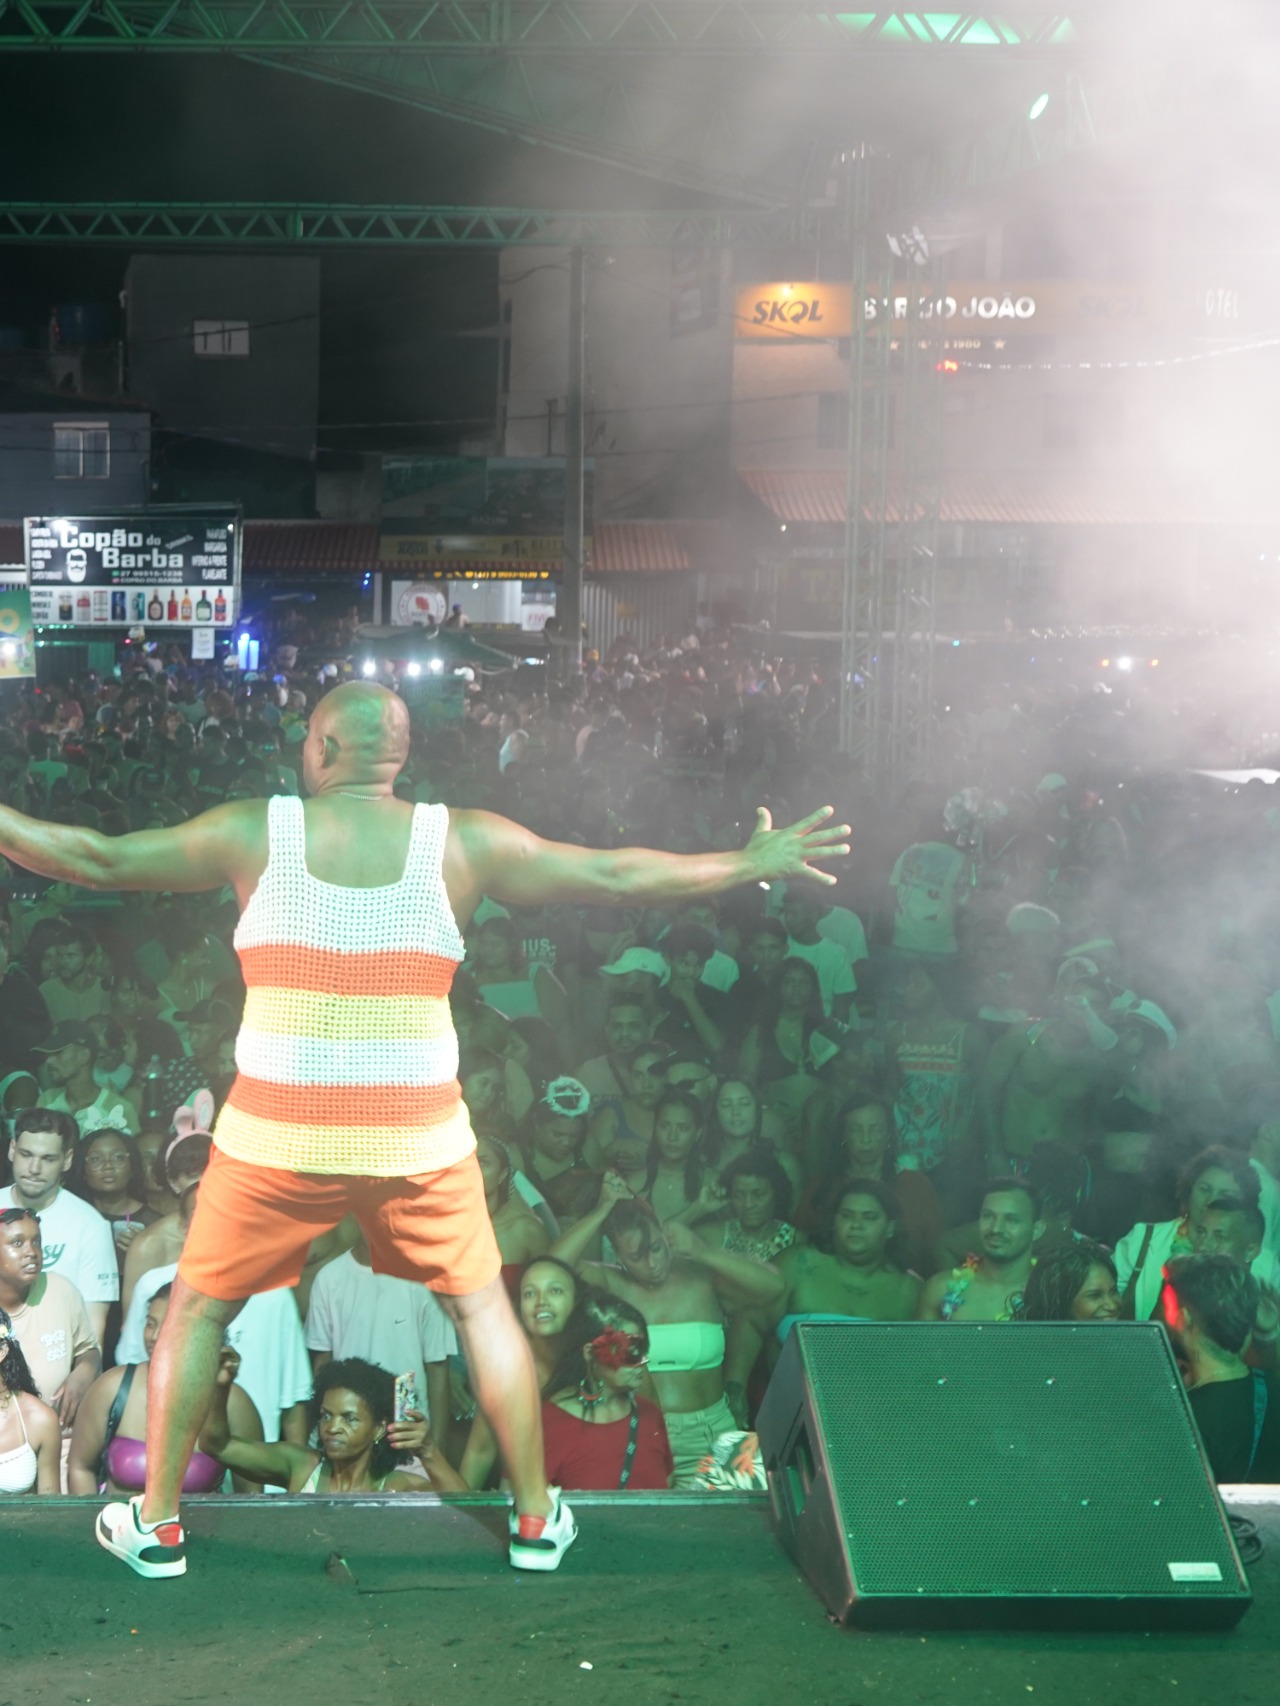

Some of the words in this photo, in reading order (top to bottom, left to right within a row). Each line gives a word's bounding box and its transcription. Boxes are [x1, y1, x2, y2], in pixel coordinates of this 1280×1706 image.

[752, 300, 823, 324] SKOL
[864, 296, 908, 320] BR
[962, 292, 1036, 319] JOÃO
[952, 340, 981, 350] 1980
[60, 525, 143, 552] Copão
[146, 534, 161, 546] do
[102, 547, 184, 568] Barba
[43, 1243, 66, 1269] sy
